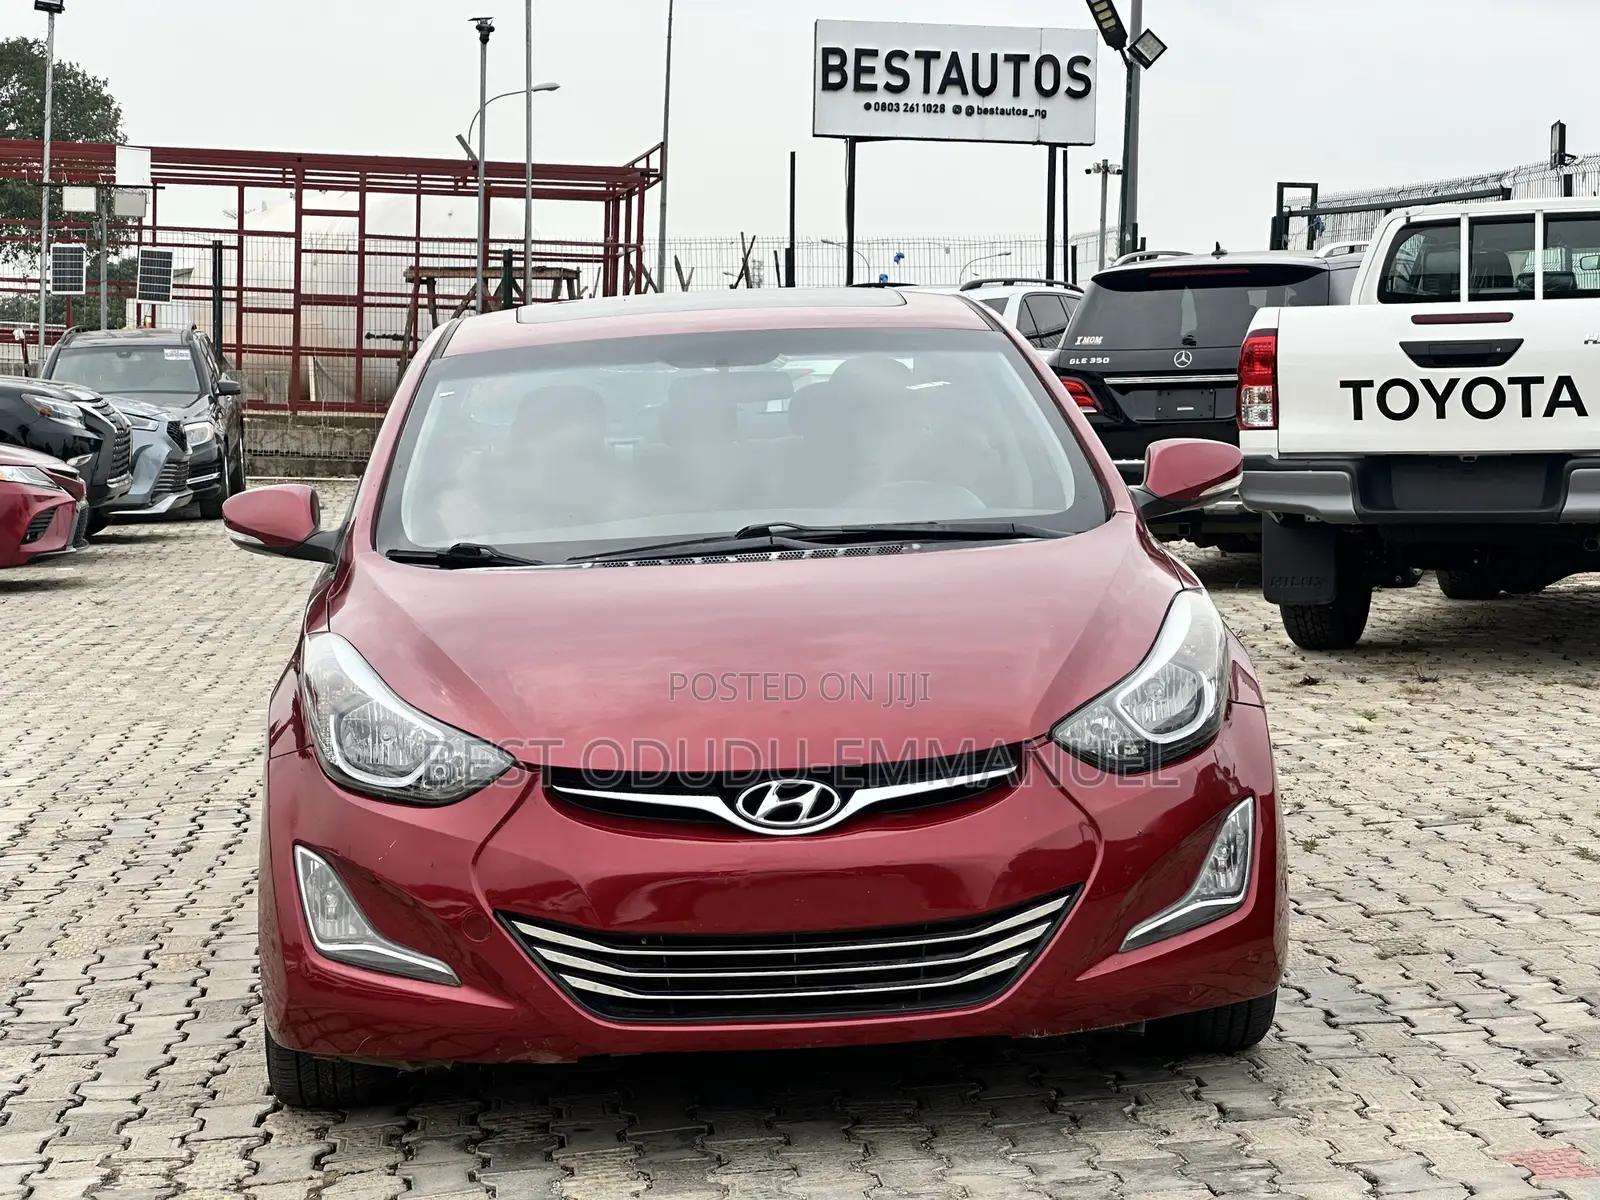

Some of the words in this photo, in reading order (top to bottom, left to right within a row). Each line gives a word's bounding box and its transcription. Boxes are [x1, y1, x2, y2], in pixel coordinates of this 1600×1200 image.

[821, 47, 1093, 99] BESTAUTOS
[873, 102, 901, 113] 0803
[902, 103, 920, 113] 261
[922, 103, 946, 114] 1028
[1069, 357, 1088, 365] GLE
[1339, 375, 1589, 421] TOYOTA
